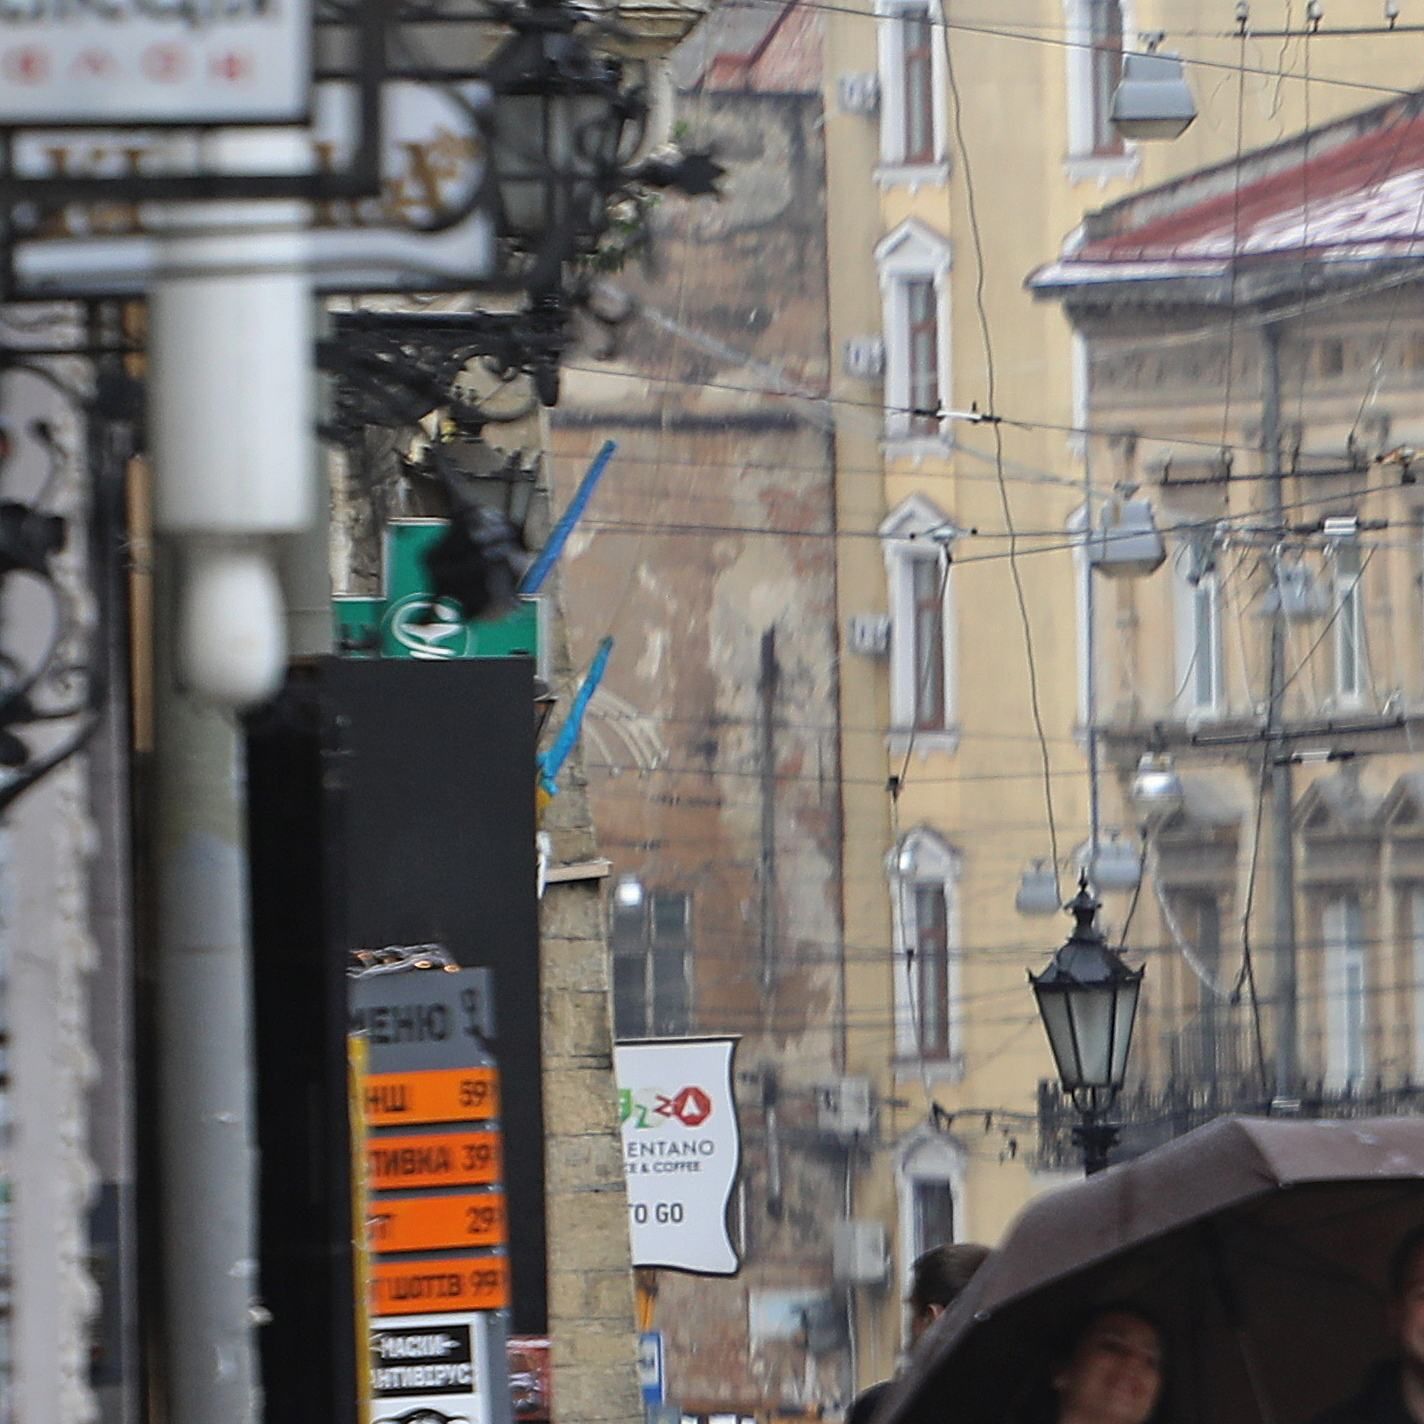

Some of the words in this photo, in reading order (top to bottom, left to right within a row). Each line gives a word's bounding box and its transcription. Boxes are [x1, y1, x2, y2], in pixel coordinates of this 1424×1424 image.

[462, 1143, 490, 1170] 39
[653, 1161, 702, 1173] COFFEE
[467, 1206, 496, 1233] 29
[656, 1203, 683, 1223] GO
[471, 1270, 499, 1296] 99
